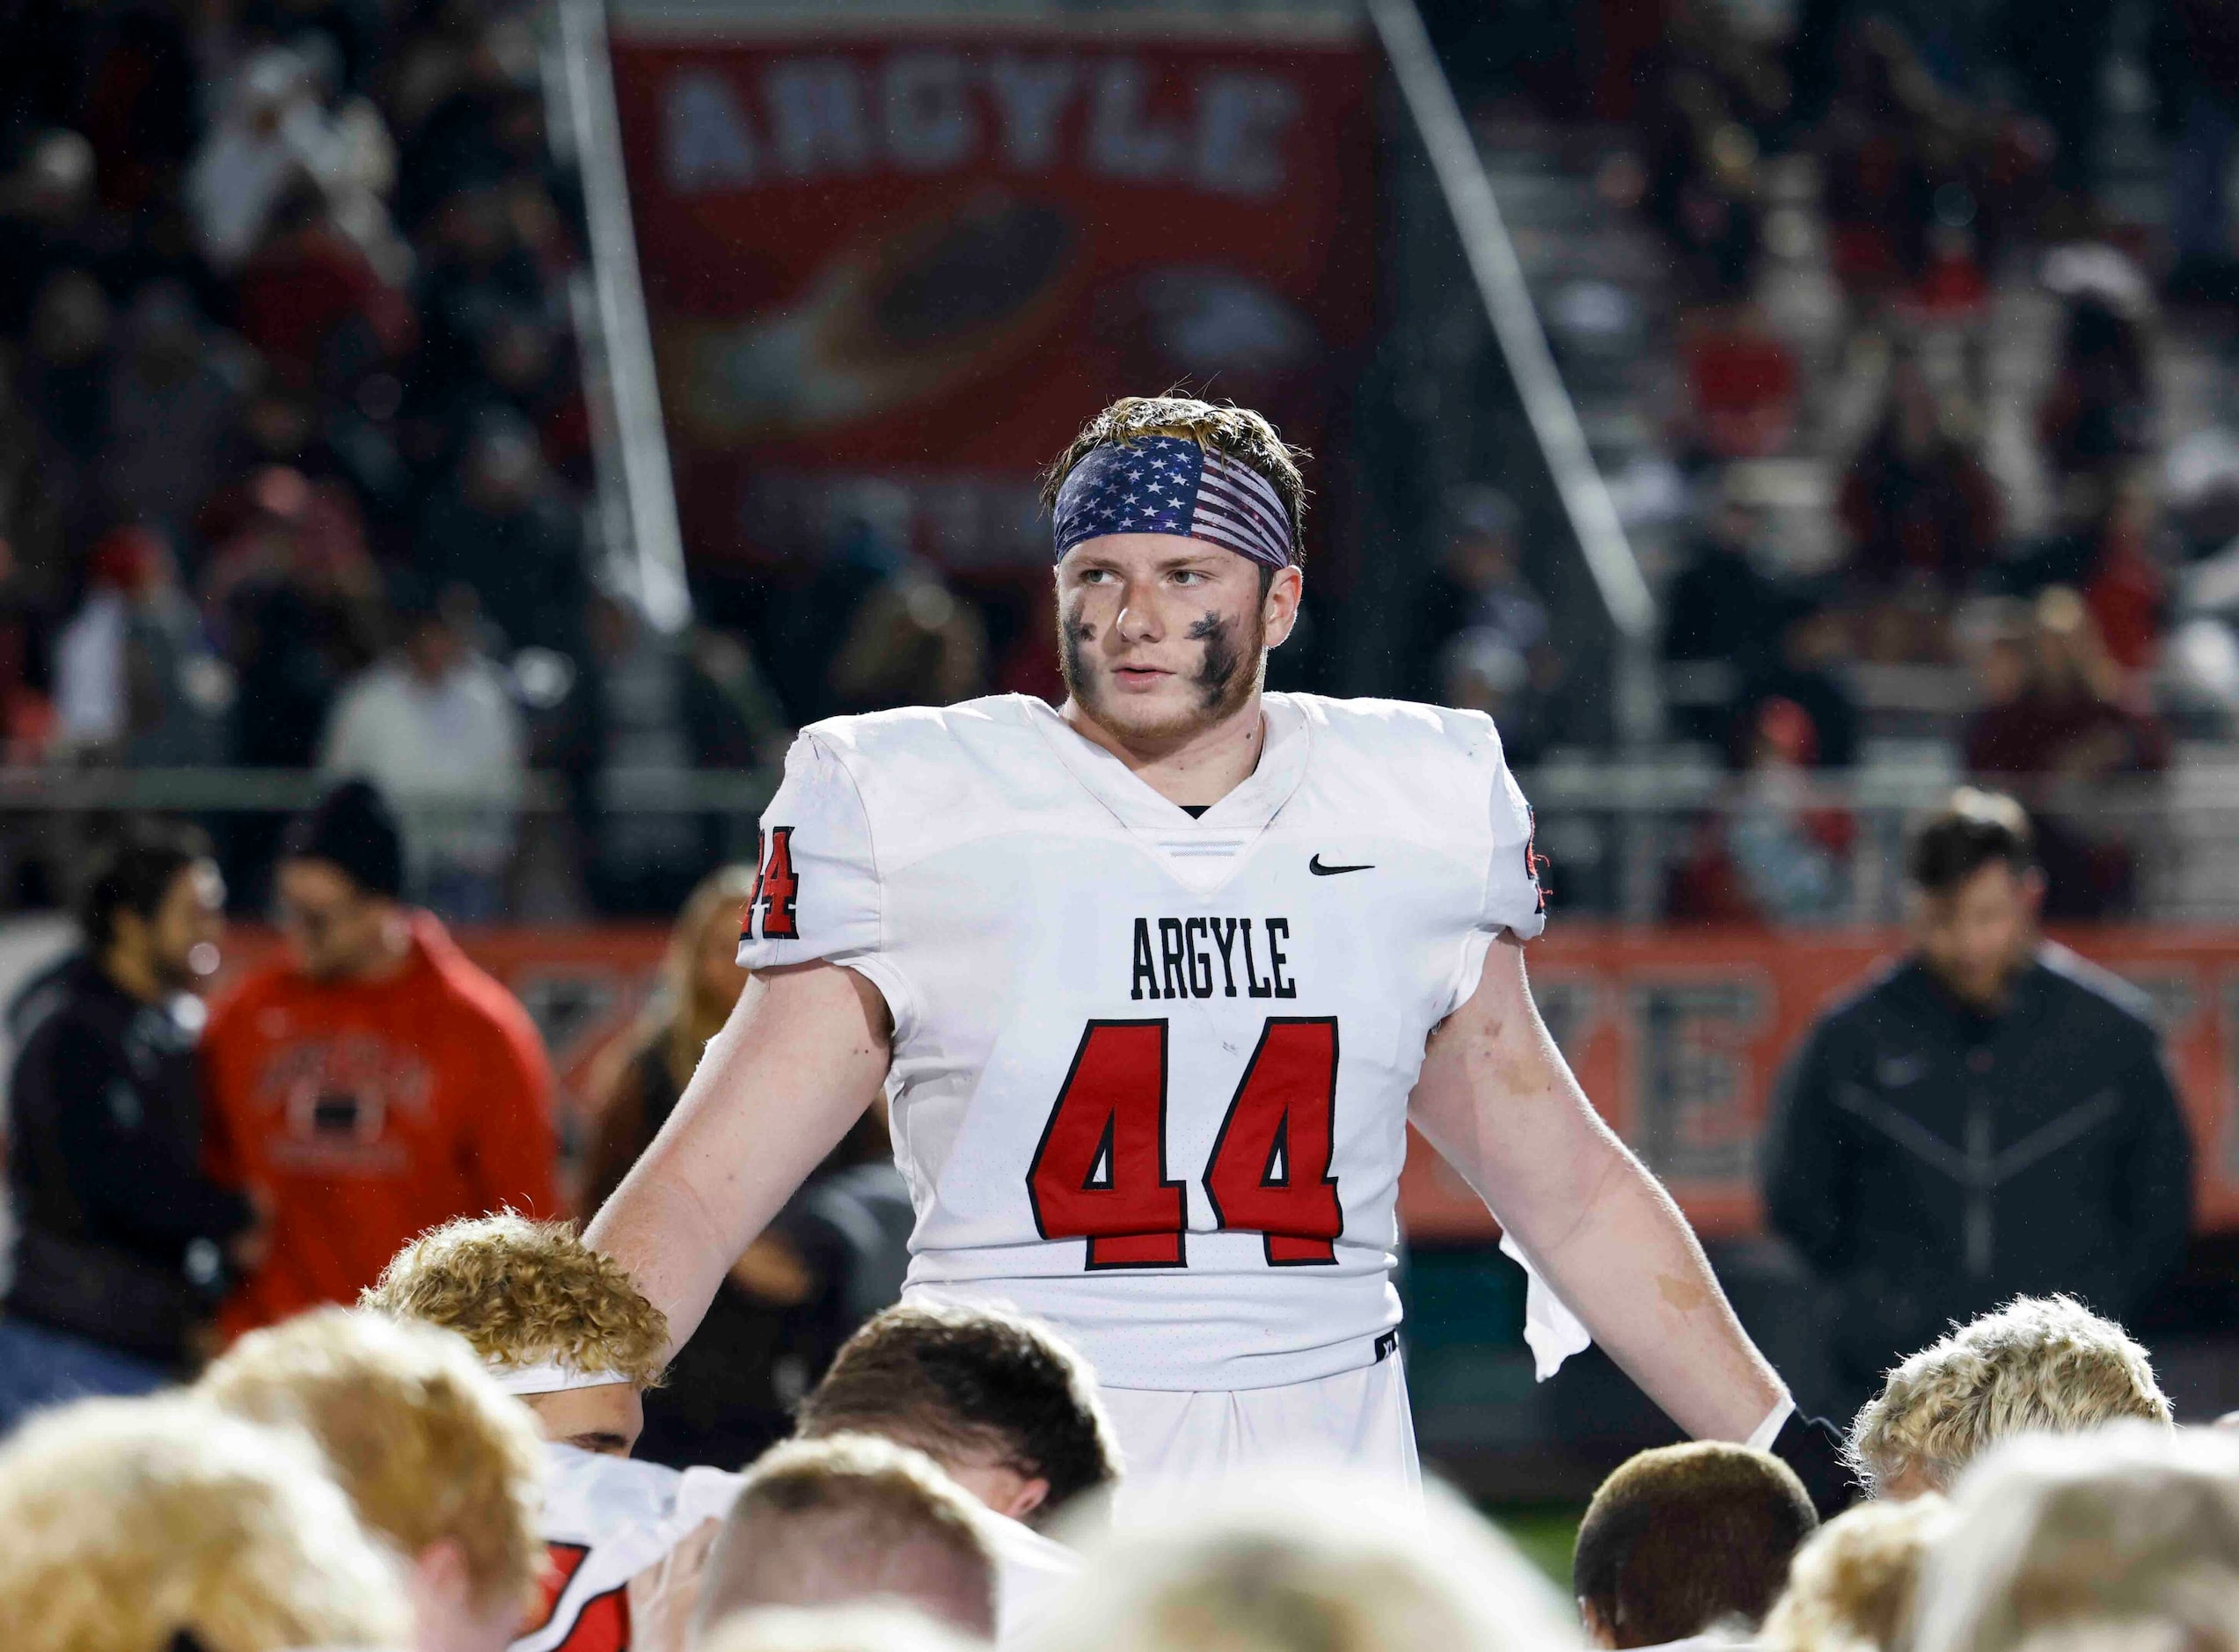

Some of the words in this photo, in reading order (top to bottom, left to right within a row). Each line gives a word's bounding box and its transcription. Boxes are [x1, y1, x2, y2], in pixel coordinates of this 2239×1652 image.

[662, 51, 1302, 195] ARGYLE
[1130, 917, 1297, 1000] ARGYLE
[1025, 1015, 1343, 1271] 44
